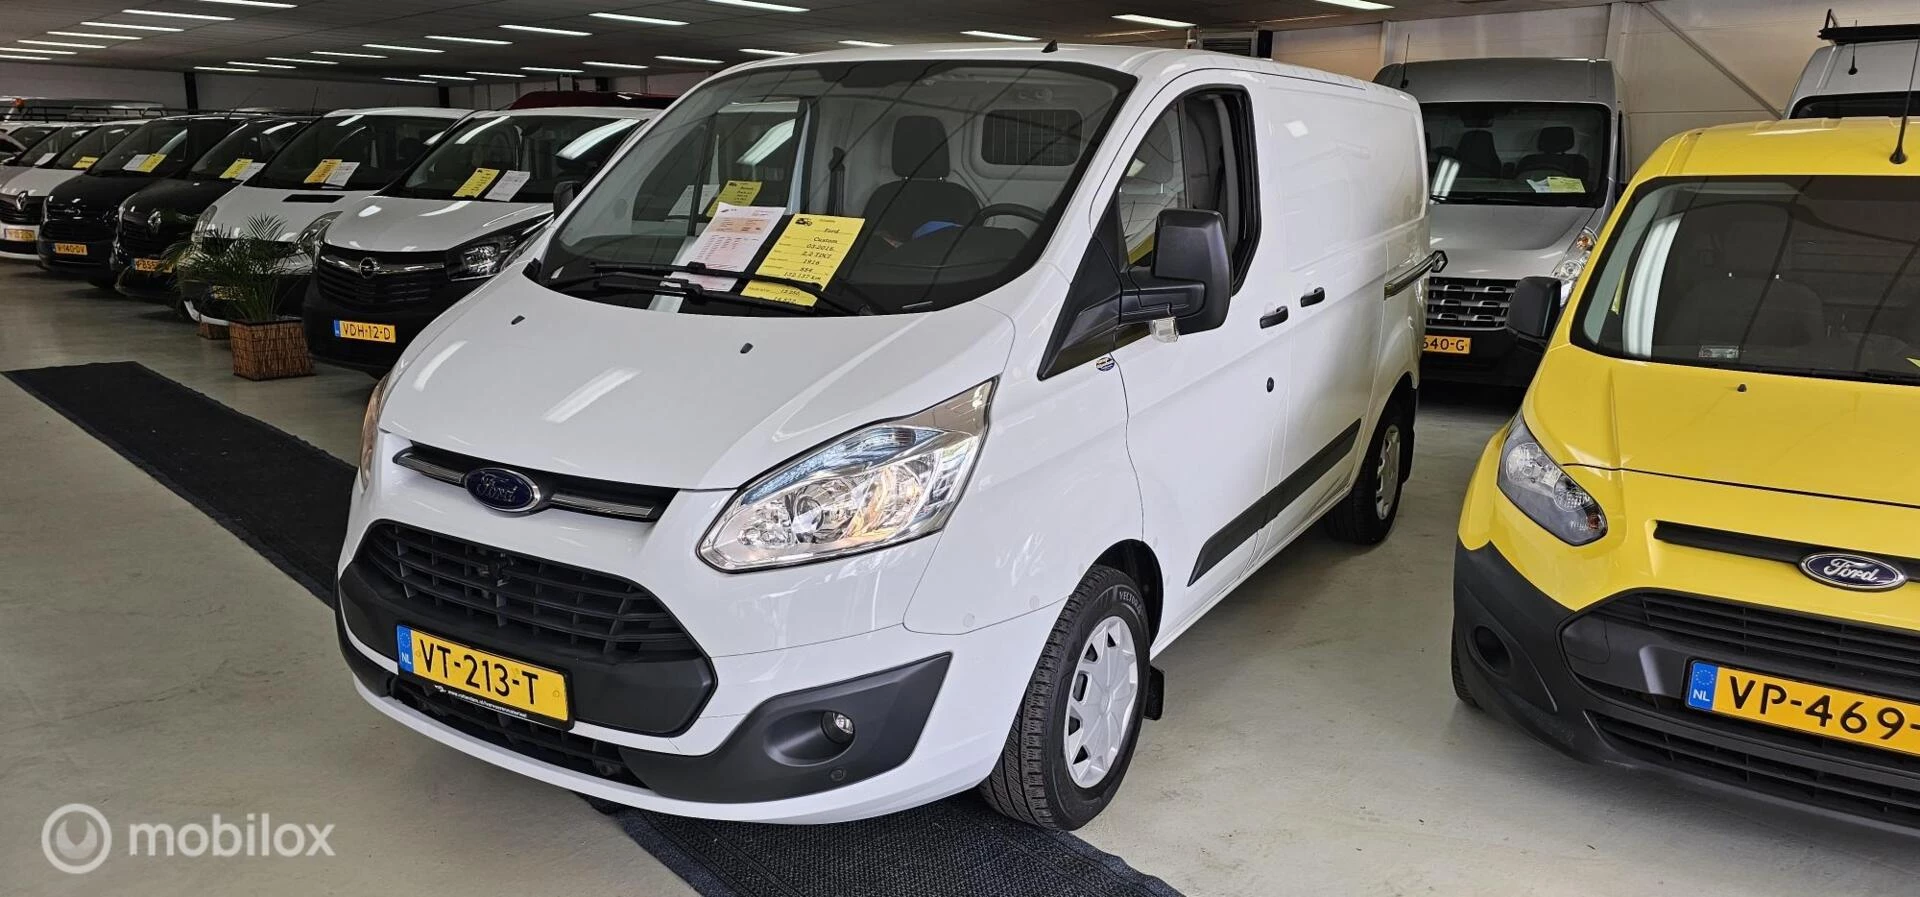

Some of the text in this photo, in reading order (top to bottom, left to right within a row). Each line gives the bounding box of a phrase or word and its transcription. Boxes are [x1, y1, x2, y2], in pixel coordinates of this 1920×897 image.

[813, 236, 838, 244] Custom
[343, 323, 391, 340] VDH-12-D
[1823, 557, 1879, 583] Ford
[401, 639, 539, 705] NL VT-213-T
[1692, 688, 1711, 702] NL
